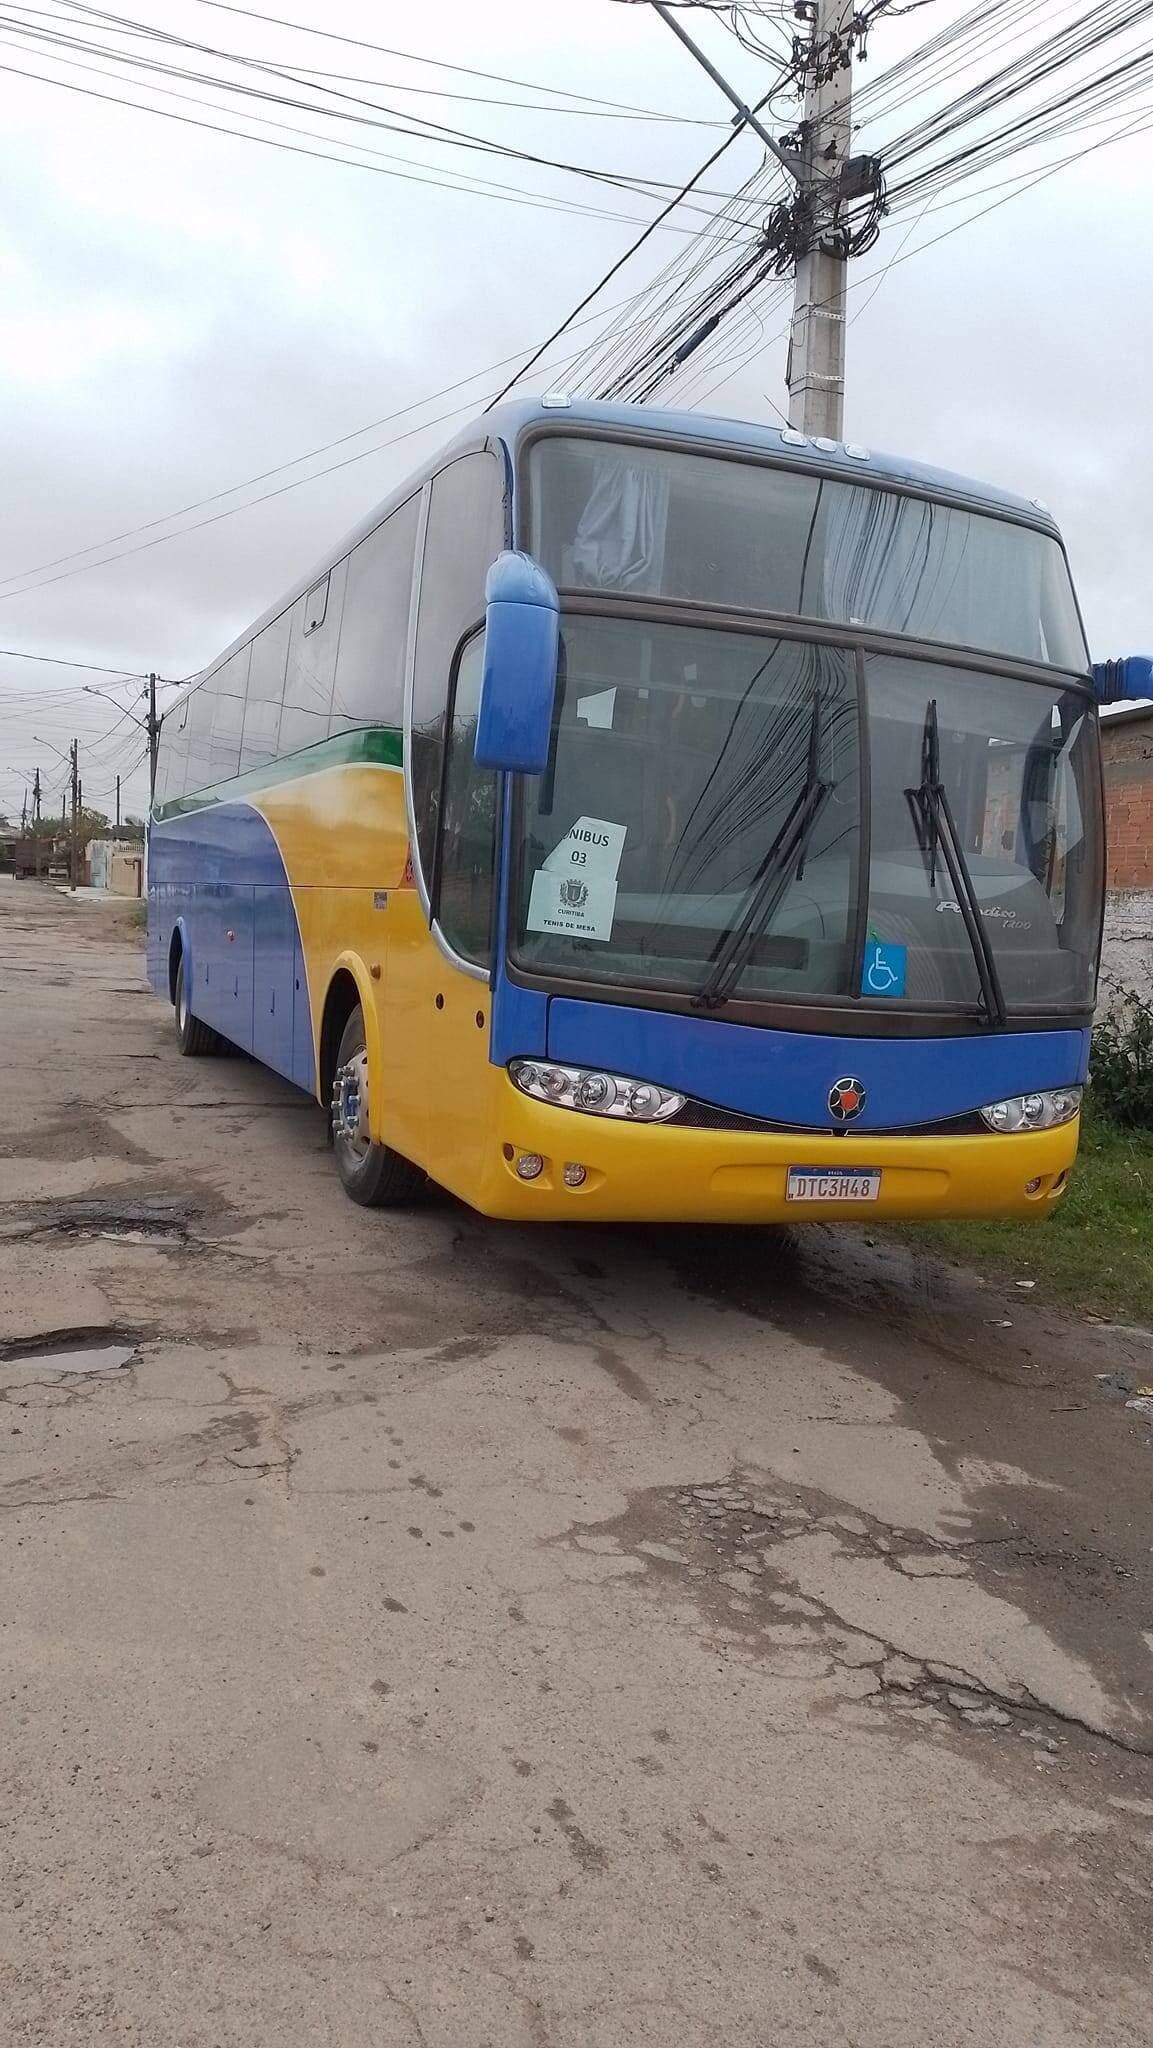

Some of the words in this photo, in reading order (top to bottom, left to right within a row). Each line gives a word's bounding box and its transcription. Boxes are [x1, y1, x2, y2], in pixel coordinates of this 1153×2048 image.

[571, 850, 587, 864] 03
[558, 909, 585, 917] CURITIBA
[1002, 920, 1032, 930] 1200
[797, 1178, 871, 1197] DTC3H48
